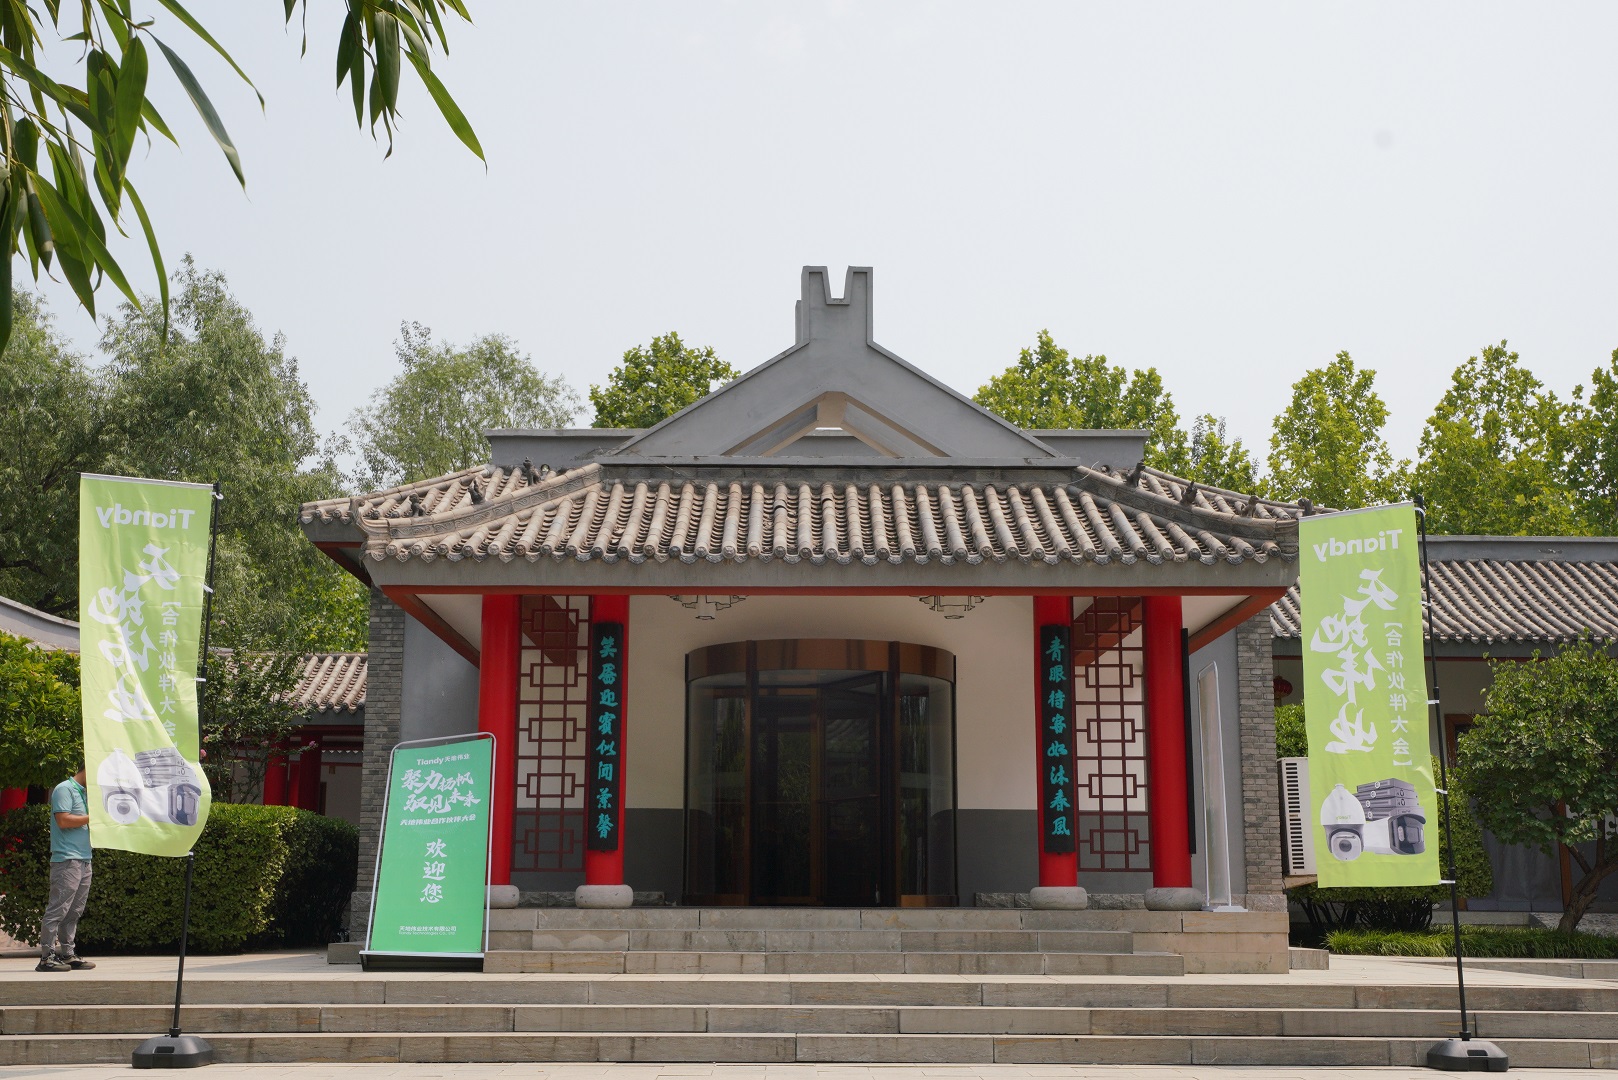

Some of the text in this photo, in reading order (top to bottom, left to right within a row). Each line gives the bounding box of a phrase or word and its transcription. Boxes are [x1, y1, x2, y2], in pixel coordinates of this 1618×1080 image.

[417, 756, 444, 767] Tiandy
[401, 769, 474, 795] 聚力扬帆
[403, 787, 482, 814] 驭见未来
[399, 813, 477, 826] 天地伟业合作伙伴大会
